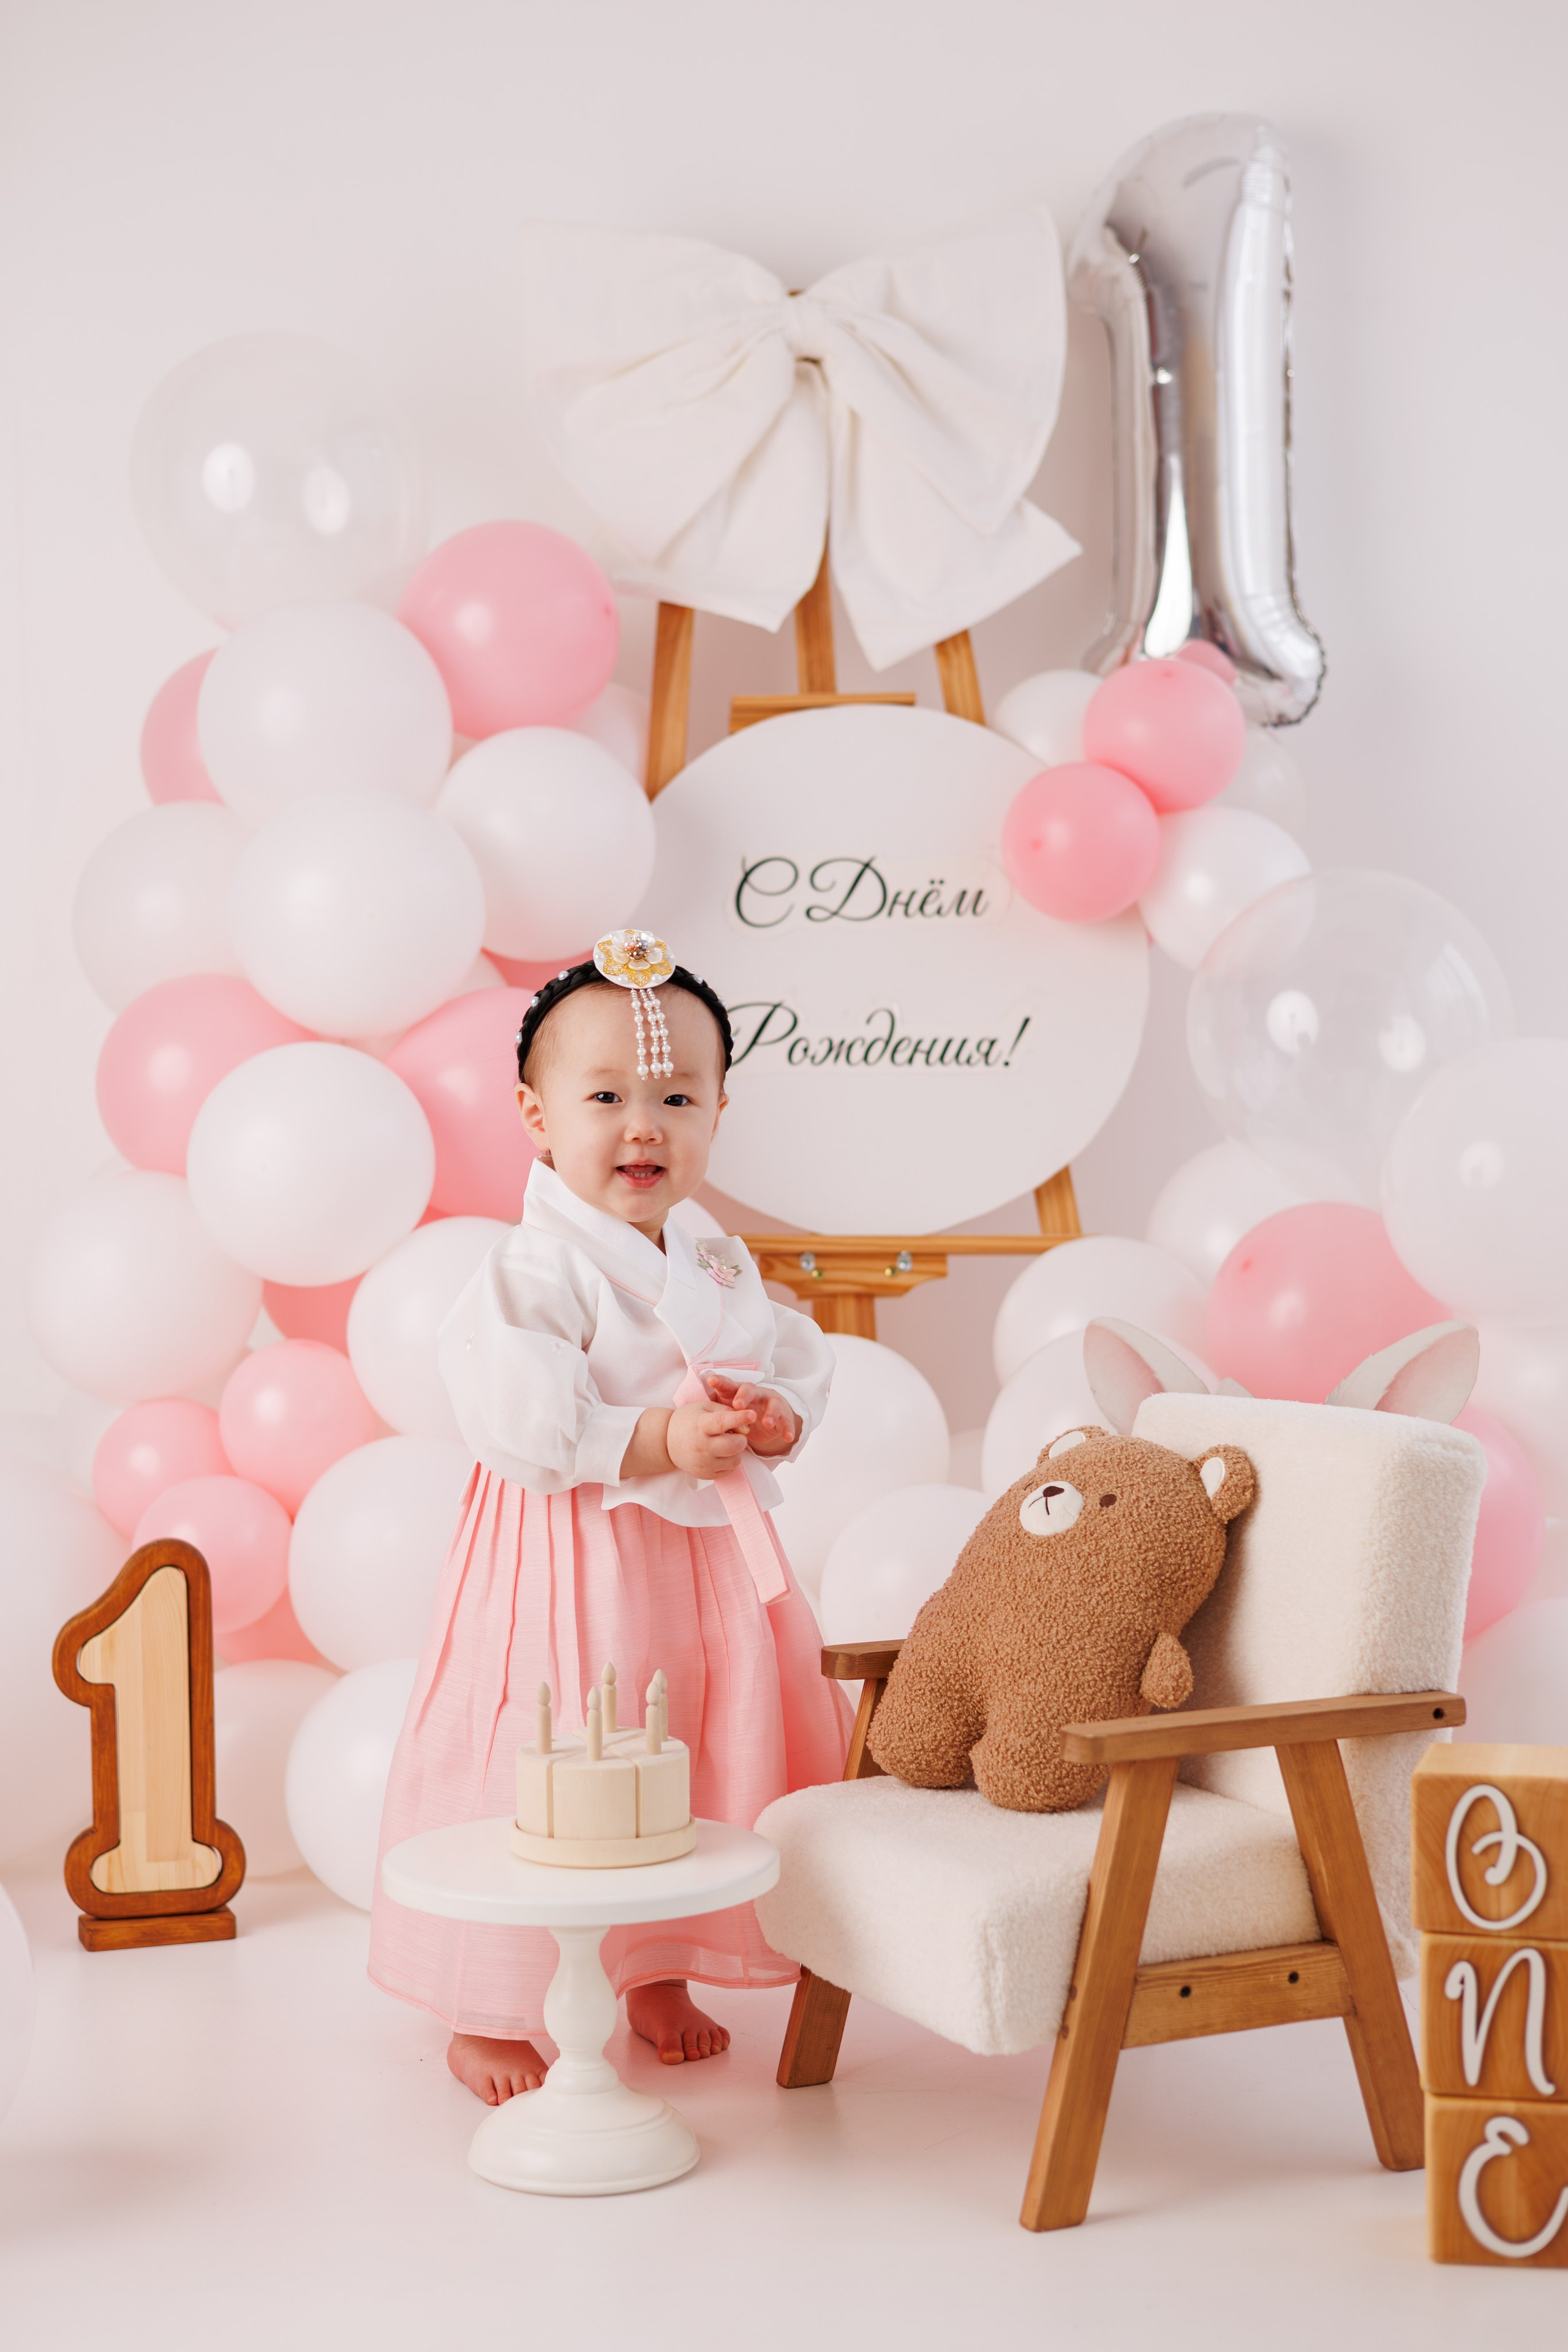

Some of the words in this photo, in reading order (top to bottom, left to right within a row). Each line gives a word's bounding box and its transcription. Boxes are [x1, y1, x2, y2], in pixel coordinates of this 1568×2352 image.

[736, 855, 799, 929] С
[805, 856, 989, 922] Днём
[726, 1000, 1031, 1068] Рождения!
[52, 1537, 246, 1920] 1
